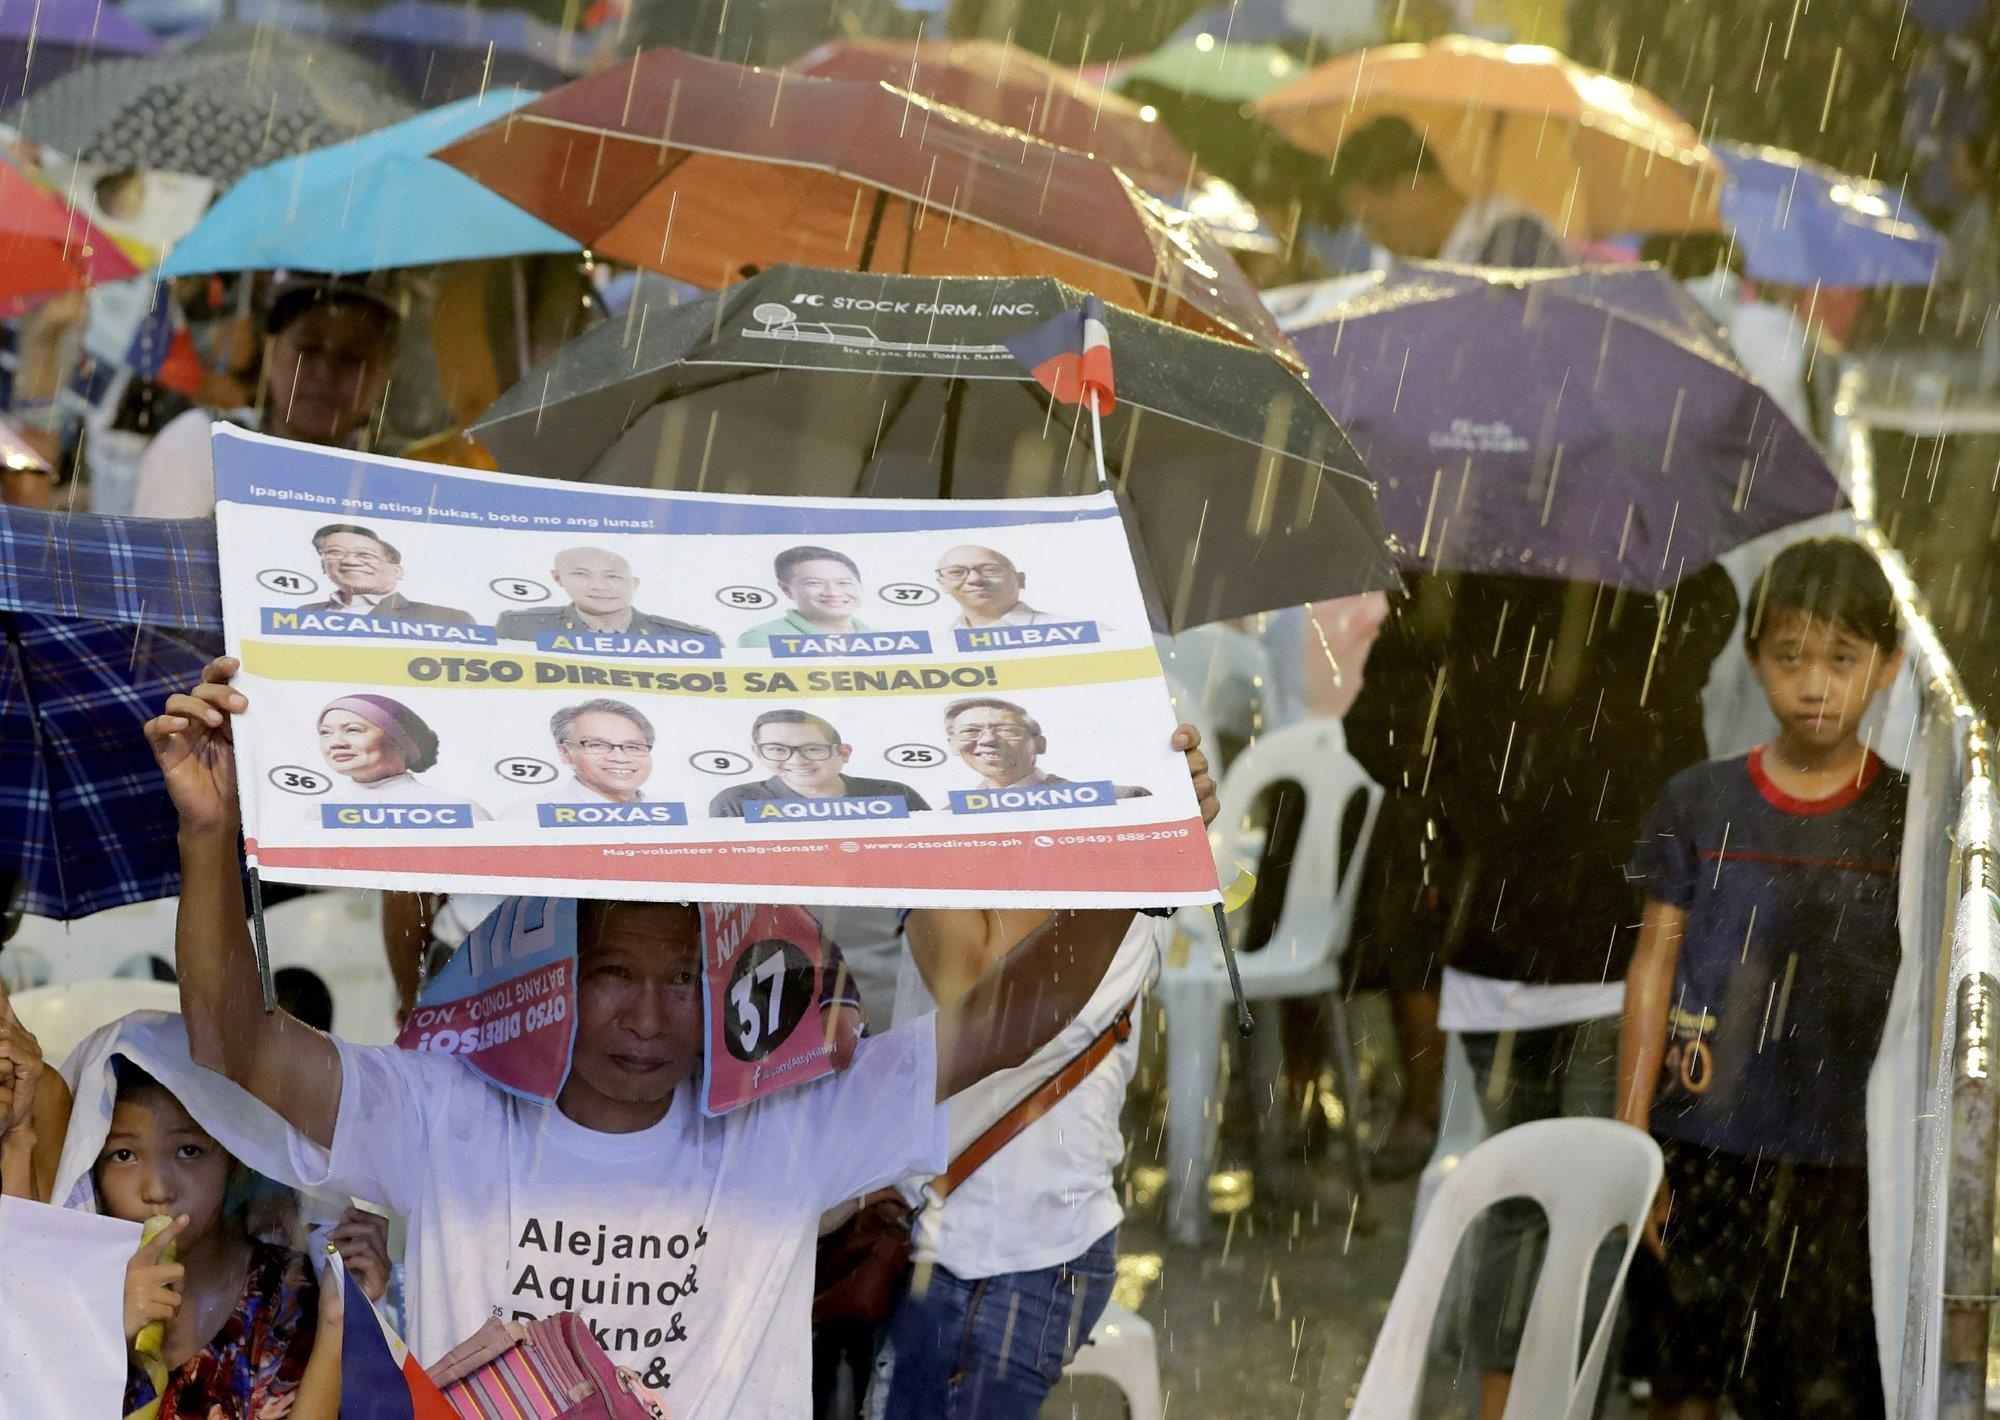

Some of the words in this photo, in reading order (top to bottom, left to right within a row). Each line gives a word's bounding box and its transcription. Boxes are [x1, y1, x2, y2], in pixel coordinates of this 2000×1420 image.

[832, 297, 910, 314] STOCK
[991, 303, 1040, 316] INC.
[250, 484, 337, 506] Ipaglaban
[341, 498, 374, 511] ang
[378, 501, 423, 515] ating
[428, 507, 483, 521] bukas,
[488, 511, 529, 524] boto
[533, 516, 561, 526] mo
[566, 517, 599, 528] ang
[603, 517, 655, 529] lunas!
[273, 574, 300, 590] 41
[512, 583, 528, 597] 5
[730, 589, 762, 605] 59
[894, 587, 924, 602] 37
[273, 612, 487, 643] MACALINTAL
[970, 624, 1085, 647] HILBAY
[551, 636, 705, 656] ALEJANO
[787, 633, 919, 653] TAÑADA
[407, 656, 524, 683] OTSO
[535, 662, 728, 692] DIRETSO!
[744, 671, 798, 692] SA
[809, 666, 998, 691] SENADO!
[714, 757, 730, 770] 9
[902, 749, 933, 763] 25
[511, 763, 542, 778] 57
[284, 773, 316, 790] 36
[965, 787, 1100, 810] DIOKNO
[337, 807, 457, 825] GUTOC
[555, 806, 671, 822] ROXAS
[760, 800, 892, 819] AQUINO
[602, 847, 714, 858] Mag-volunteer
[864, 838, 1022, 851] www.otsodiretso.ph
[516, 966, 566, 1004] BATANG
[467, 988, 514, 1020] TONDO,
[731, 949, 786, 1051] 37
[526, 995, 566, 1032] OTSO
[417, 1012, 521, 1053] DIRETSO!
[492, 1304, 504, 1317] 25
